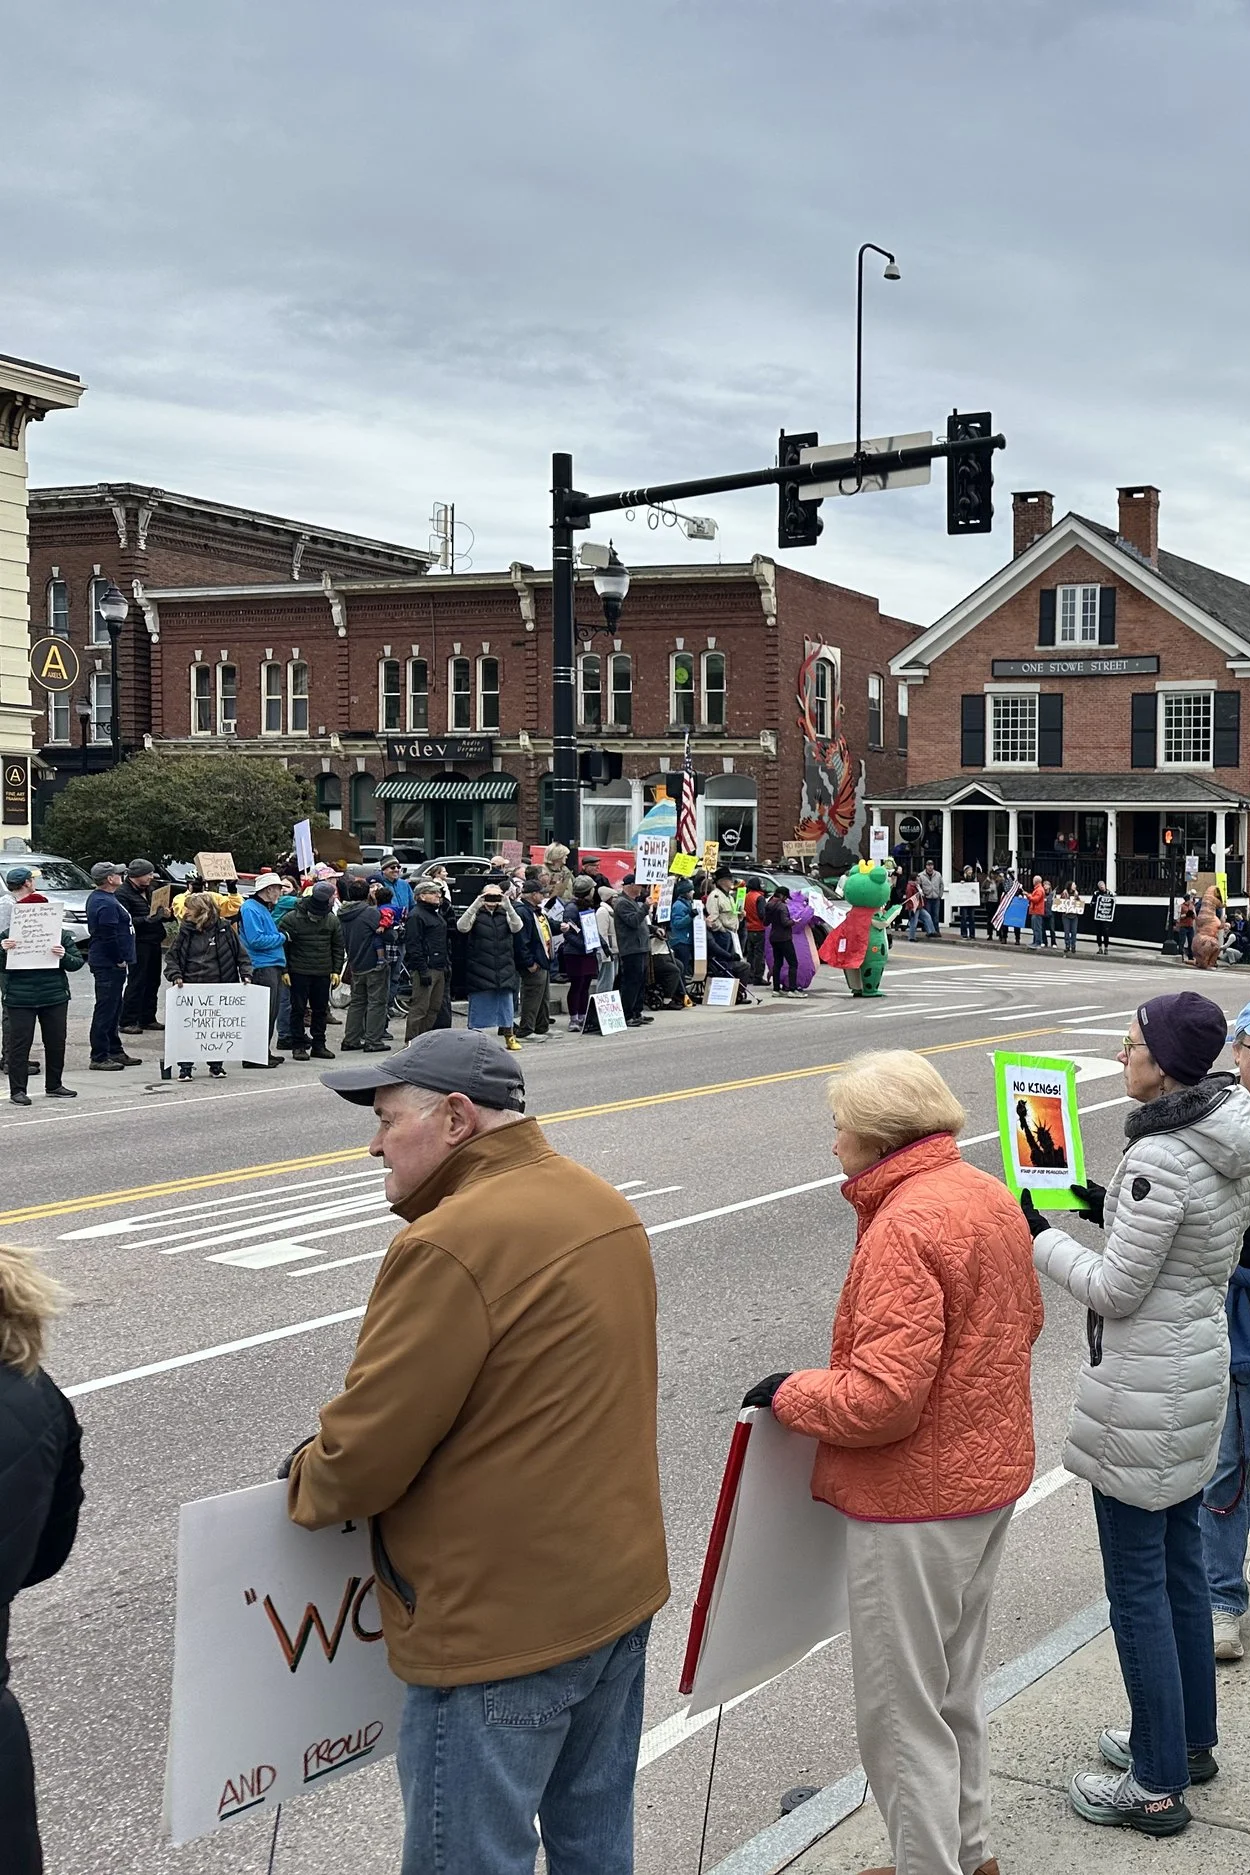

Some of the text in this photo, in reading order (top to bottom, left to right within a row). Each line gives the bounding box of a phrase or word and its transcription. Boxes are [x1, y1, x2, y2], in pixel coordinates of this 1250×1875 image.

[41, 645, 69, 680] A
[1021, 660, 1129, 673] ONE STOWE STREET
[394, 740, 448, 757] wdev
[644, 840, 666, 856] DUMP
[642, 857, 666, 868] TRUMP
[646, 870, 655, 878] NO
[175, 995, 247, 1007] CAN WE PLEASE
[183, 1017, 247, 1028] SMART PEOPLE
[195, 1032, 243, 1040] IN CHARGE
[1013, 1081, 1062, 1096] NO KINGS!
[244, 1576, 384, 1674] "WO
[217, 1720, 384, 1816] AND PROUD
[1144, 1797, 1175, 1814] HOKA
